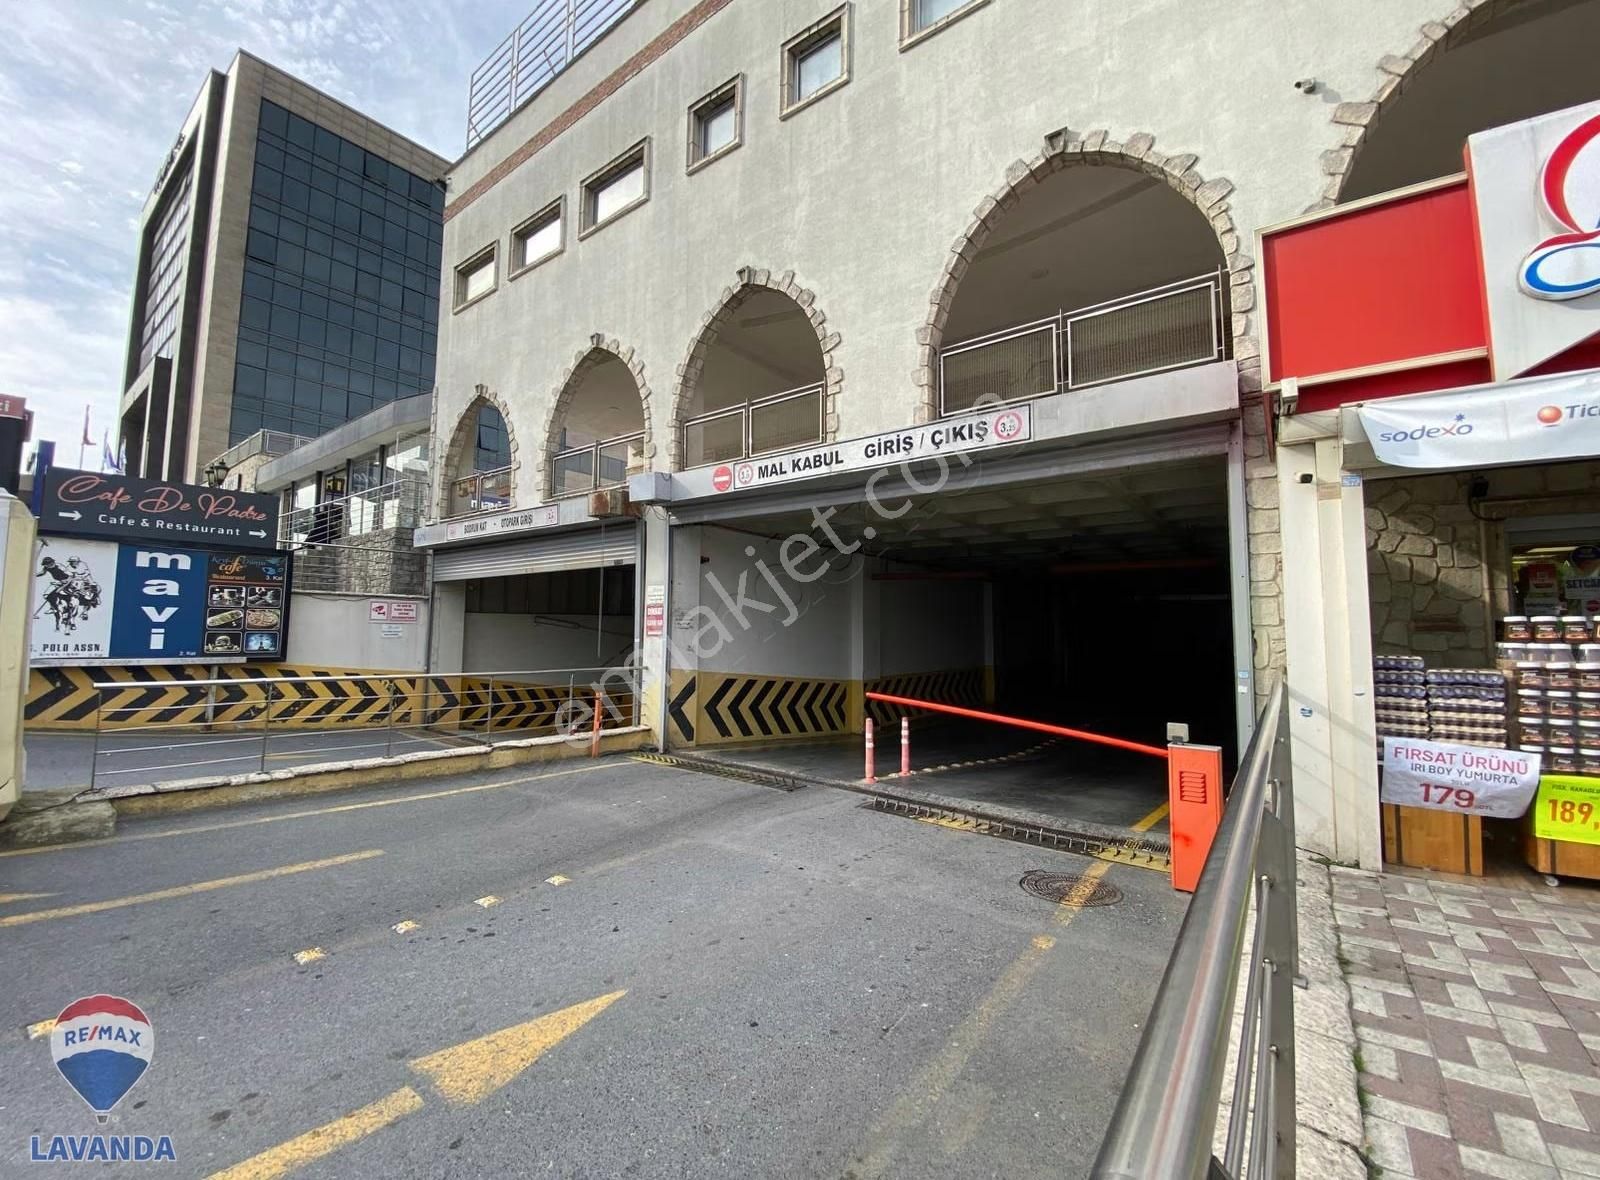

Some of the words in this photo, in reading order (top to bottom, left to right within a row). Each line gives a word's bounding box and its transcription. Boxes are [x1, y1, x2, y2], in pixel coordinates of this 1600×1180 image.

[1565, 404, 1600, 419] Tic
[1380, 425, 1473, 442] sodexo
[758, 460, 787, 479] MAL
[791, 450, 844, 473] KABUL
[864, 436, 914, 459] GİRİŞ
[930, 421, 988, 449] ÇIKIŞ
[58, 475, 132, 510] Cafe
[137, 486, 192, 513] De
[198, 493, 269, 521] Padre
[98, 514, 136, 527] Cafe
[140, 518, 150, 528] &
[155, 519, 242, 536] Restaurant
[135, 551, 191, 650] mavi
[42, 644, 69, 652] POLO
[1393, 746, 1457, 765] FIRSAT
[1462, 752, 1528, 775] ÜRÜNÜ
[1428, 766, 1453, 776] BOY
[1456, 769, 1518, 785] YUMURTA
[1419, 782, 1475, 809] 179
